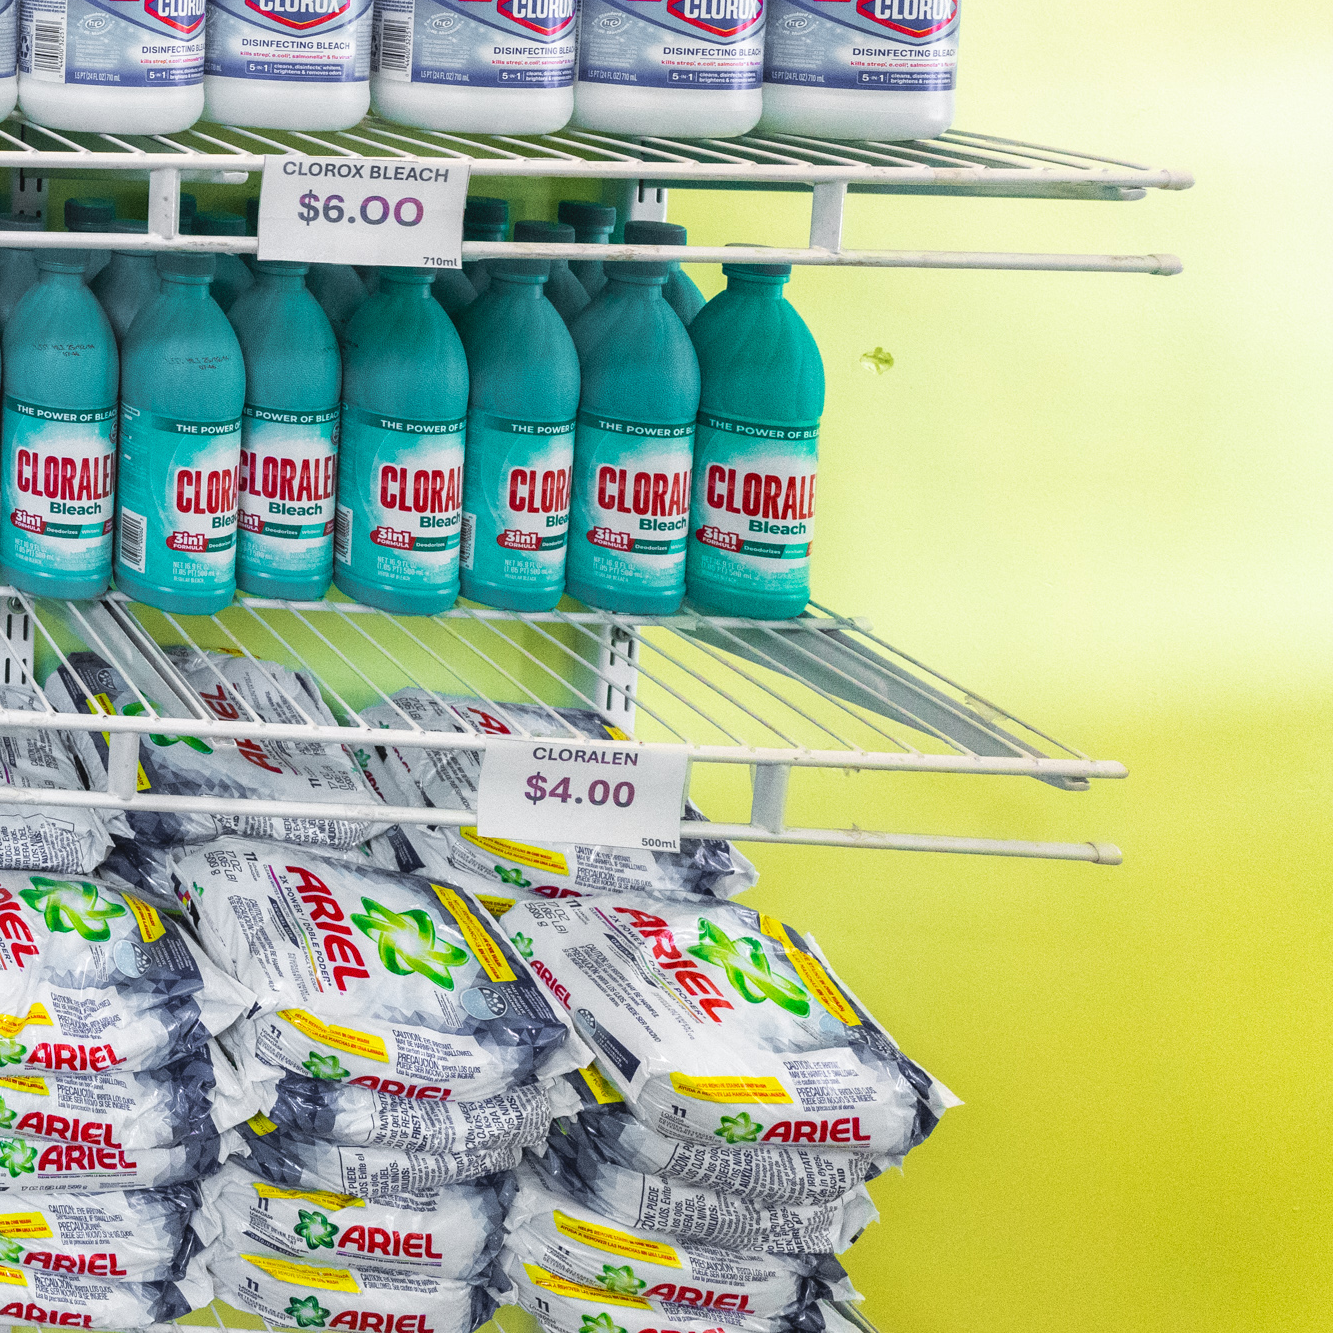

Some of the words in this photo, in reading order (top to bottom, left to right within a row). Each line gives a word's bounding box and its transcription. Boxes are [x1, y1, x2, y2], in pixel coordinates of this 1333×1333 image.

[241, 38, 314, 49] DISINFECTING
[317, 41, 350, 50] BLEACH
[283, 161, 365, 178] CLOROX
[370, 166, 449, 182] BLEACH
[298, 190, 424, 226] $6.00
[423, 257, 457, 266] 710ml
[749, 520, 806, 535] Bleach
[533, 746, 638, 767] CLORALEN
[525, 771, 635, 808] $4.00
[641, 837, 677, 848] 500ml
[286, 866, 370, 992] ARIEL
[613, 907, 734, 1023] ARIEL
[25, 1042, 127, 1071] ARIEL
[671, 1105, 686, 1117] 11
[16, 1112, 121, 1148] ARIEL
[761, 1117, 871, 1142] ARIEL
[338, 1225, 442, 1258] ARIEL
